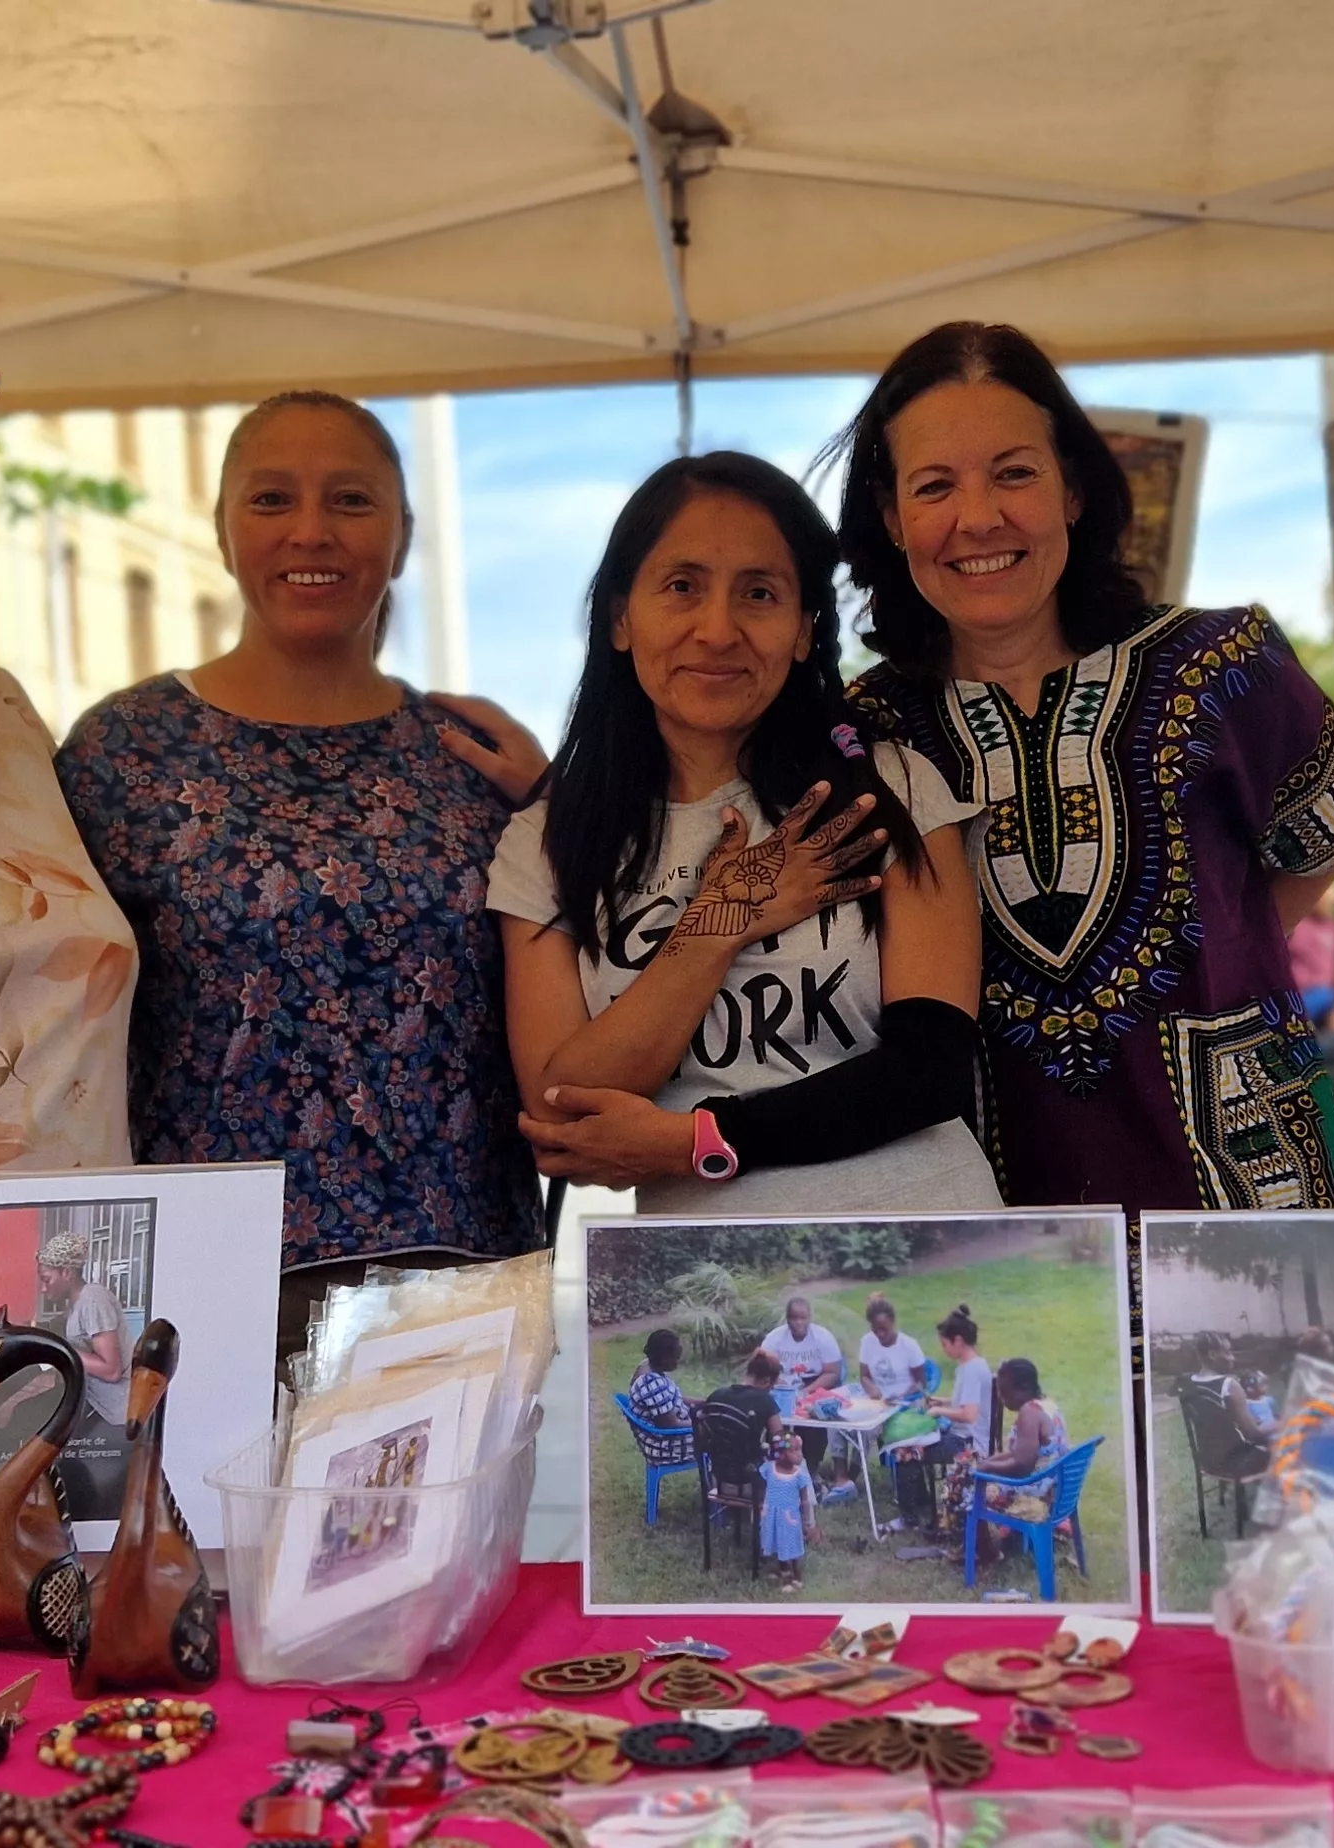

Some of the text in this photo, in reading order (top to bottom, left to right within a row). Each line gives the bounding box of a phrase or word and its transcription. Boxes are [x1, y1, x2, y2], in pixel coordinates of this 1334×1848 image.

[610, 958, 857, 1081] ORK
[94, 1437, 106, 1446] de
[64, 1450, 77, 1459] de
[78, 1449, 122, 1459] Empresas
